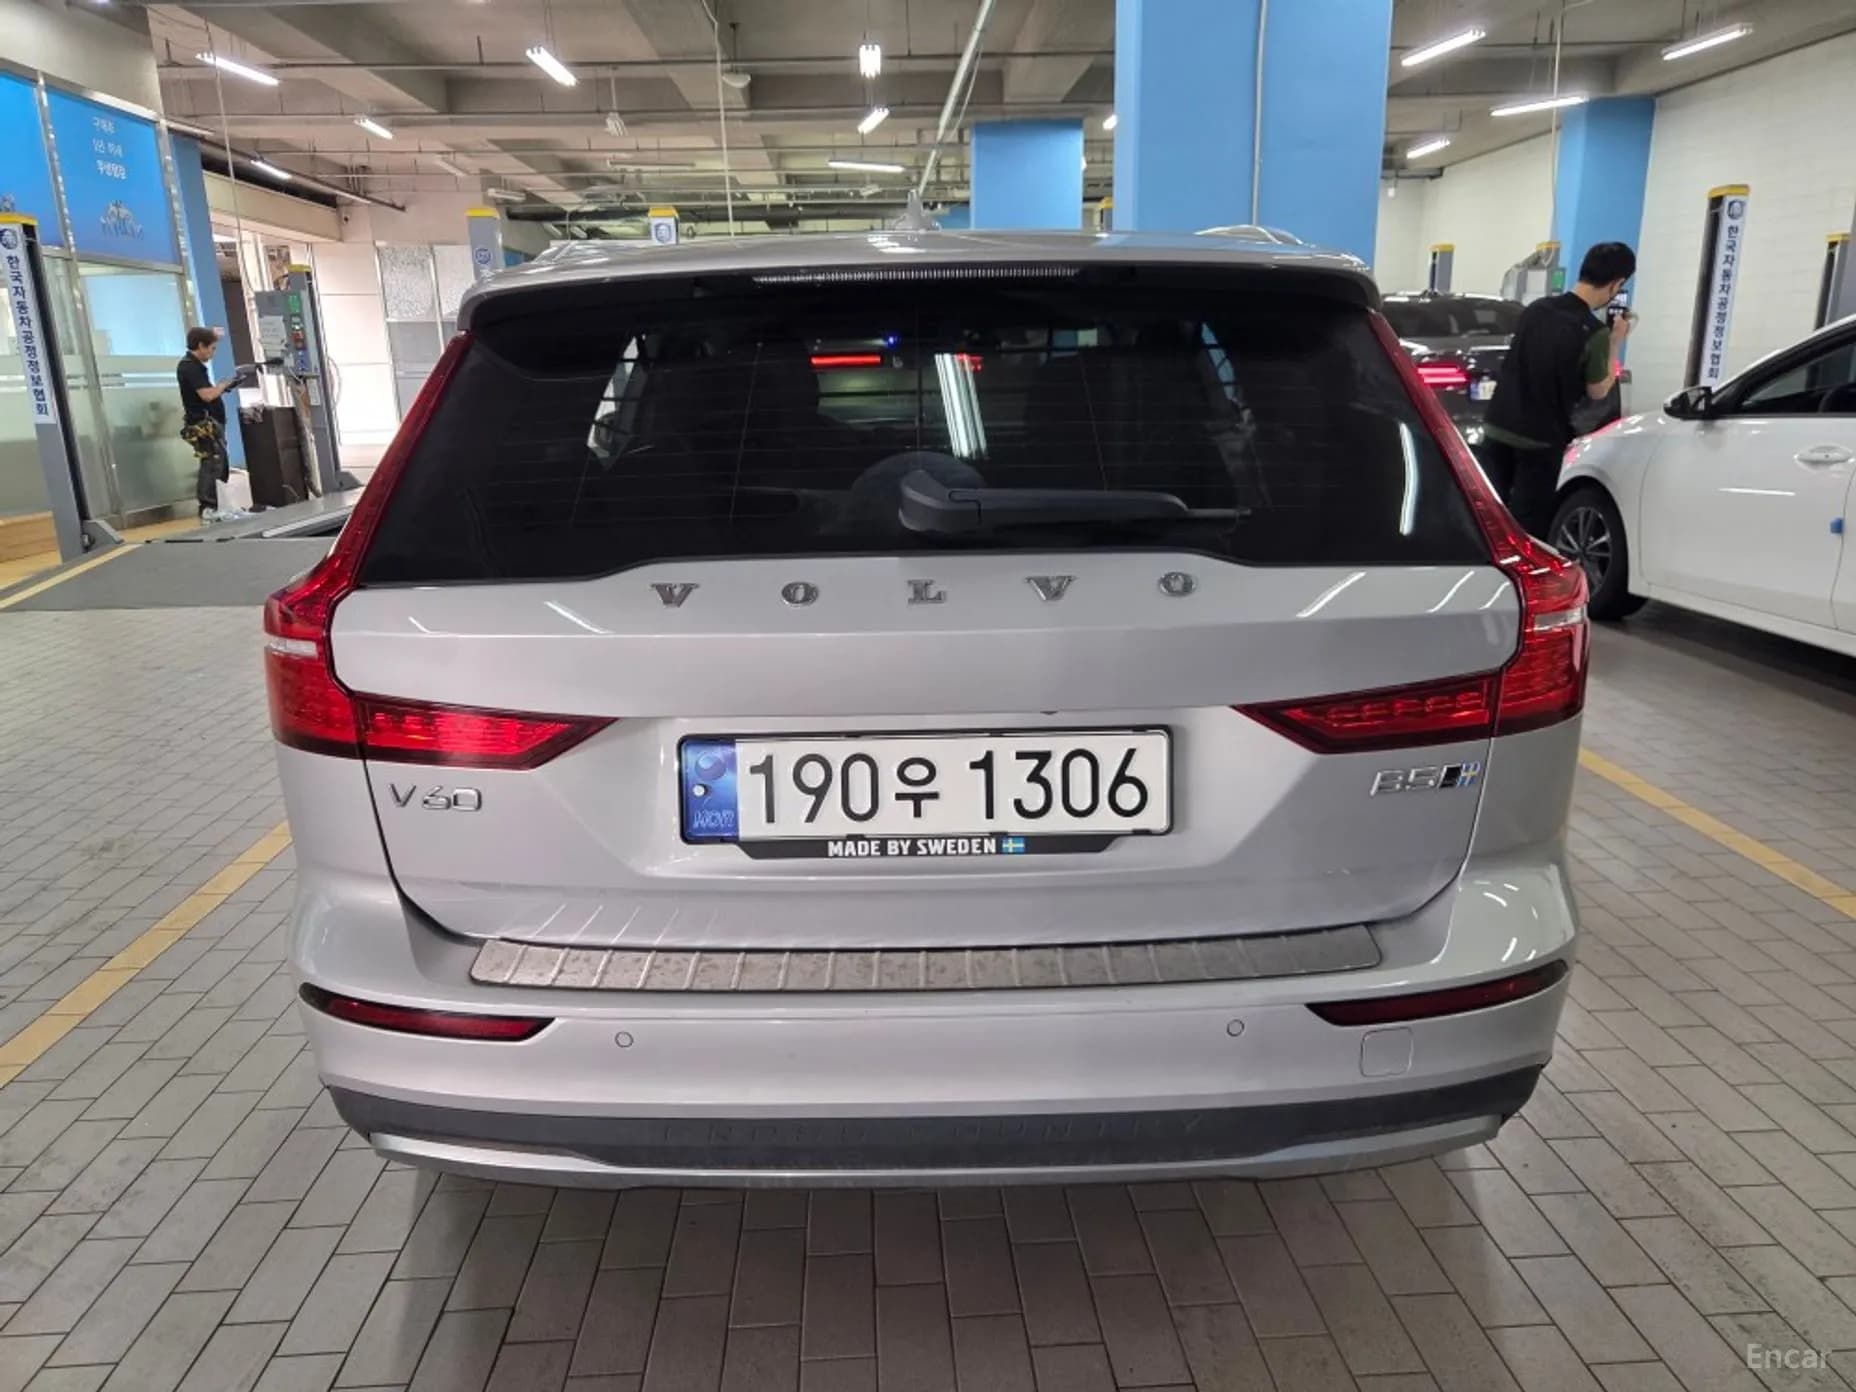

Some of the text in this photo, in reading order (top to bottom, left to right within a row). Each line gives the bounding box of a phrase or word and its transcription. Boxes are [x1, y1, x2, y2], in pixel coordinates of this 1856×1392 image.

[650, 571, 1196, 607] VOLVO
[388, 783, 482, 812] V60
[749, 748, 1149, 824] 190우 1306
[828, 838, 997, 857] MADE BY SWEDEN
